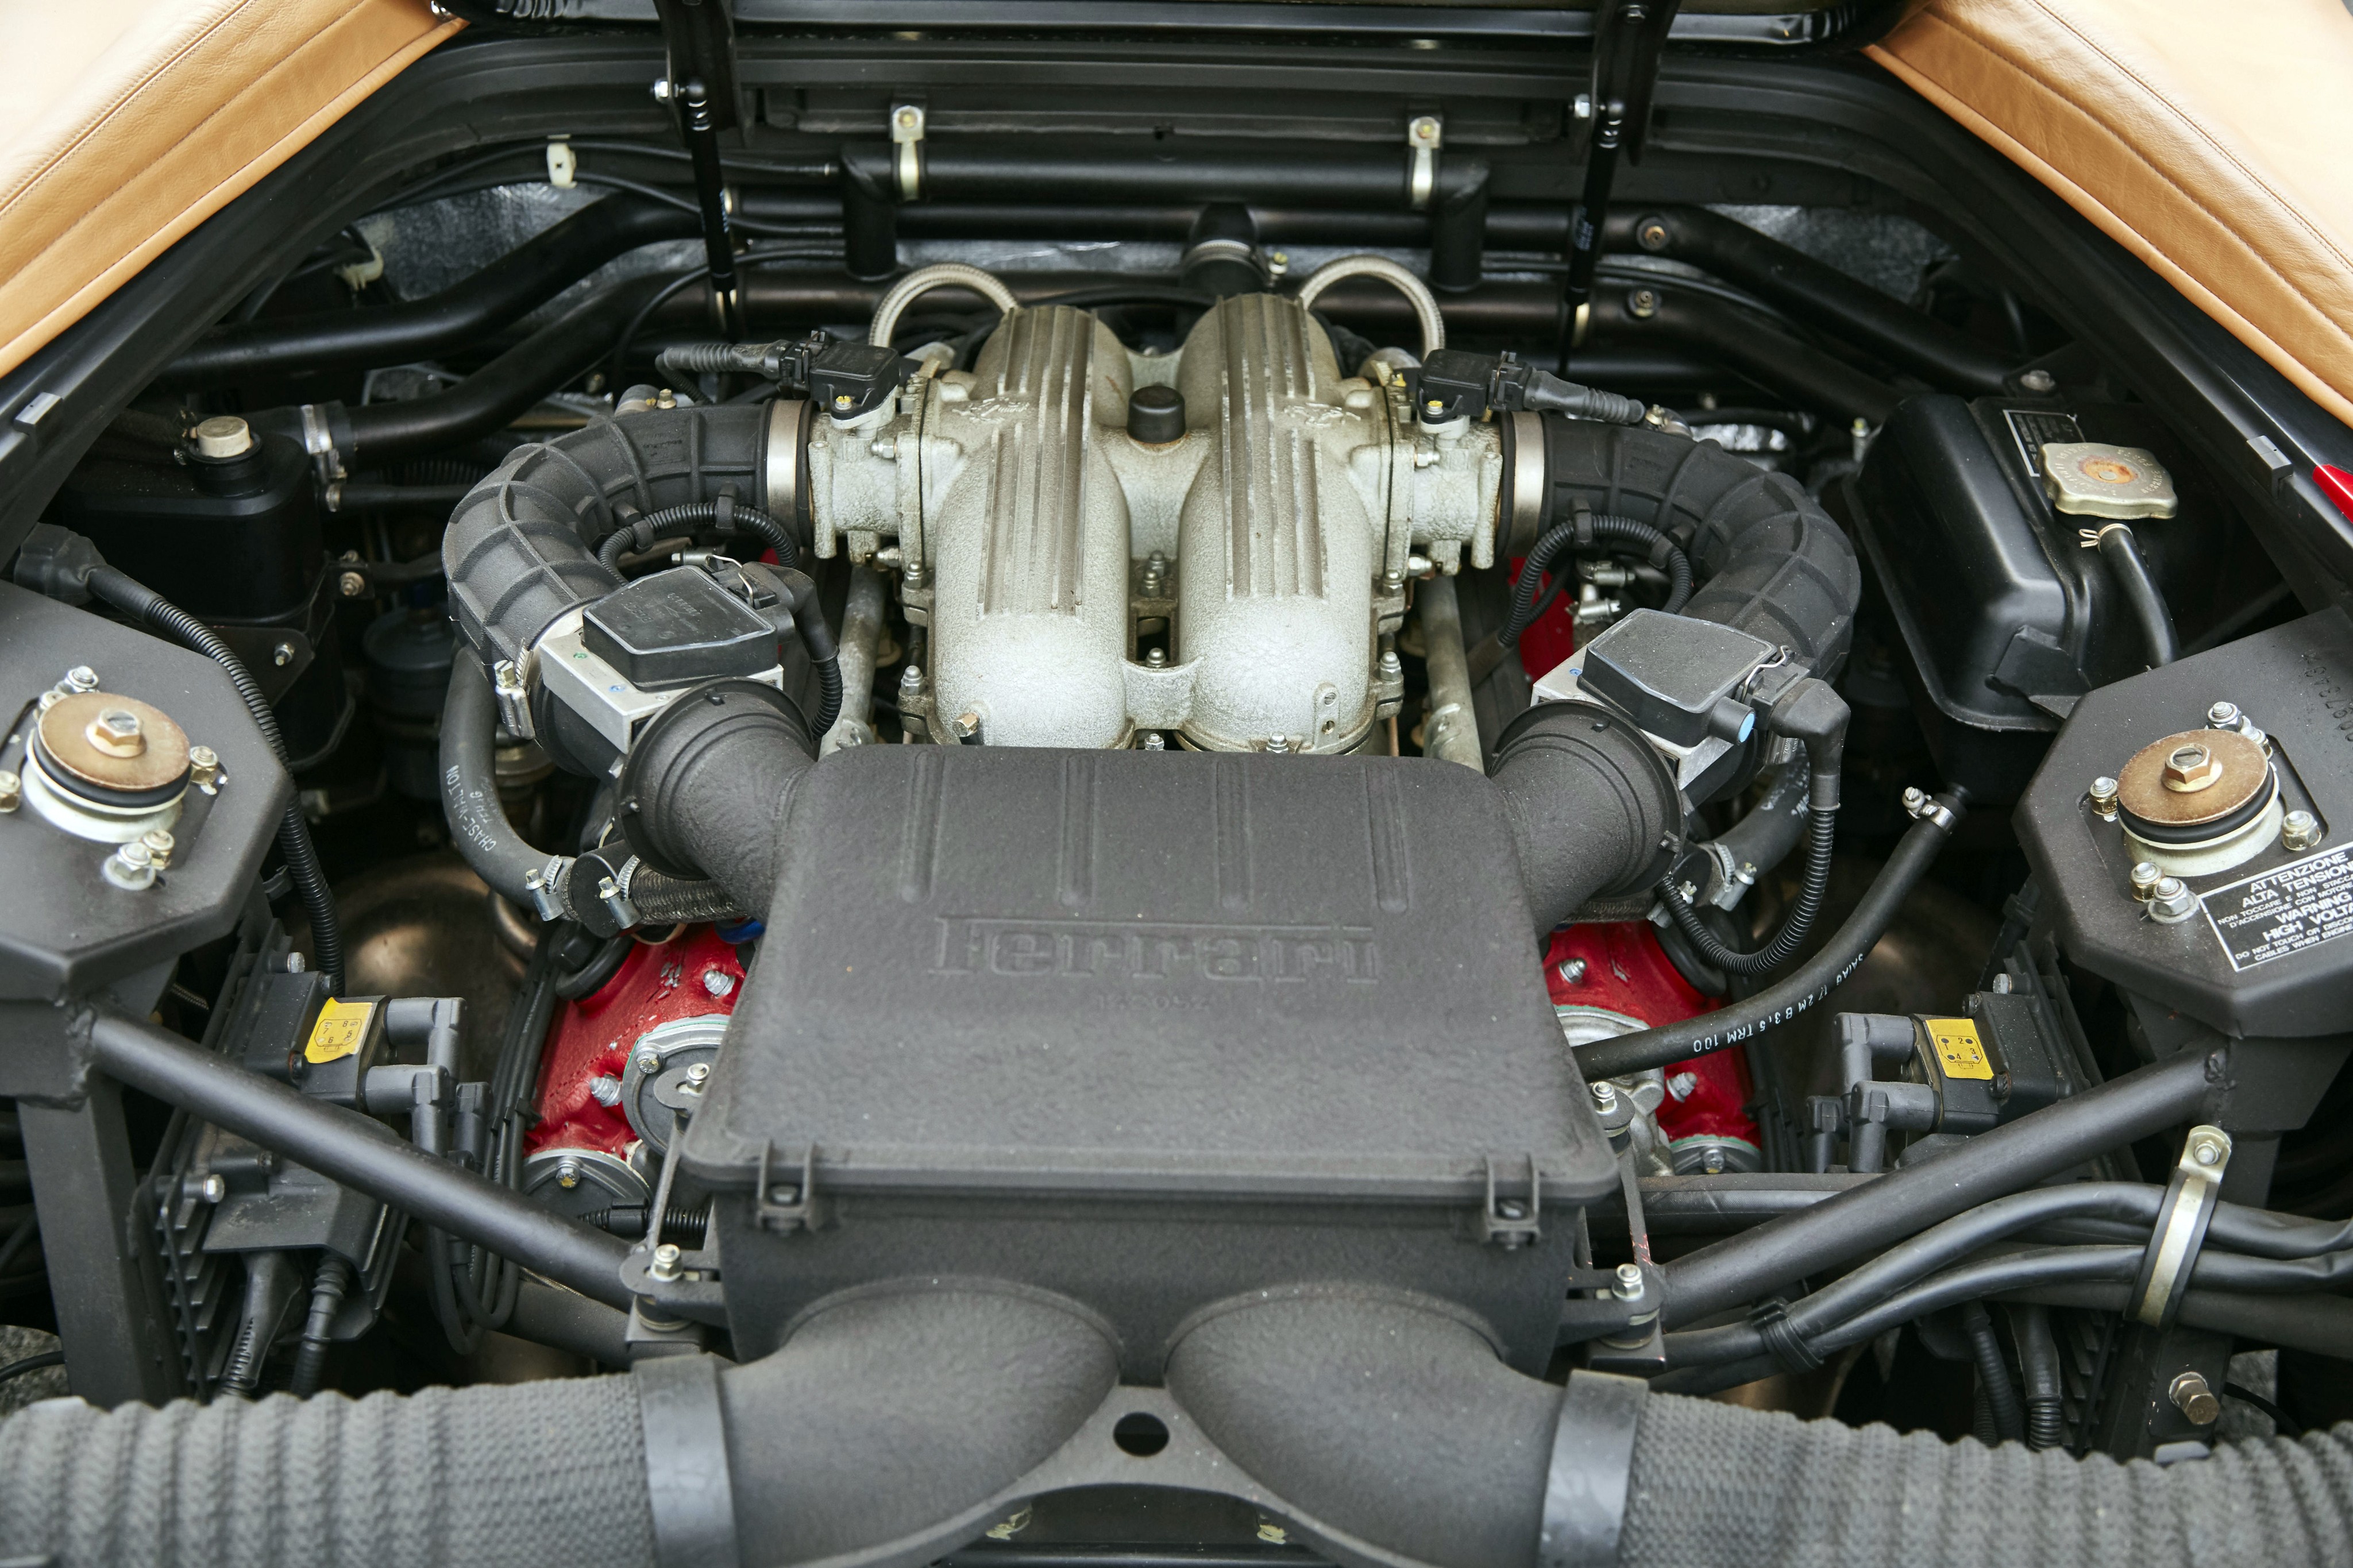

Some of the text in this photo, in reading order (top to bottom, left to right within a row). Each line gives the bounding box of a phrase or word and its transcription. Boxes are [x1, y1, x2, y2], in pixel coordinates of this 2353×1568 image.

[446, 764, 496, 851] CHASE-WALTON
[2242, 861, 2353, 907] ALTA TENSION
[2251, 851, 2348, 893] ATTENZIONE
[2217, 914, 2238, 925] NON
[2240, 899, 2282, 917] TOCCARE
[2296, 887, 2317, 899] NON
[2229, 882, 2353, 928] D'ACCENSIONE CON MOTORE
[2275, 891, 2352, 924] WARNING
[2235, 951, 2250, 960] DO
[2251, 944, 2270, 955] NOT
[2272, 933, 2304, 947] TOUCH
[2306, 927, 2320, 936] OR
[2254, 923, 2353, 961] CABLES WHEN ENGINE
[2262, 921, 2304, 941] HIGH
[1785, 1006, 1793, 1019] B
[1694, 1034, 1719, 1052] 100
[1727, 1024, 1754, 1044] TRM
